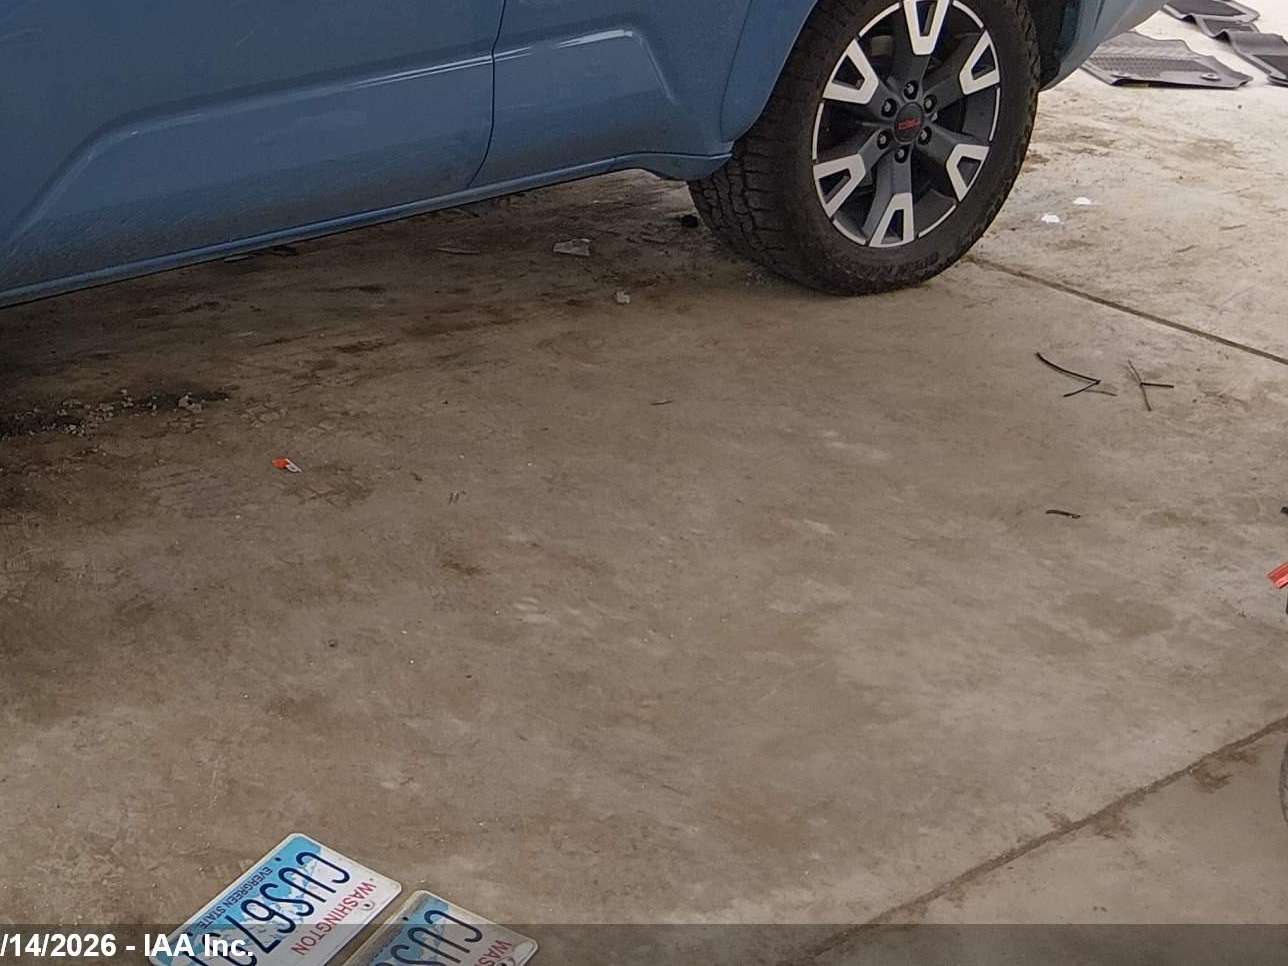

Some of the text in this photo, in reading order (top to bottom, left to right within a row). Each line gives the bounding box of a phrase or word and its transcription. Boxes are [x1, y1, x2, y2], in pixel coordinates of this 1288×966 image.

[197, 866, 273, 929] EVERGREEN STATE
[291, 881, 377, 955] WASHINGTON
